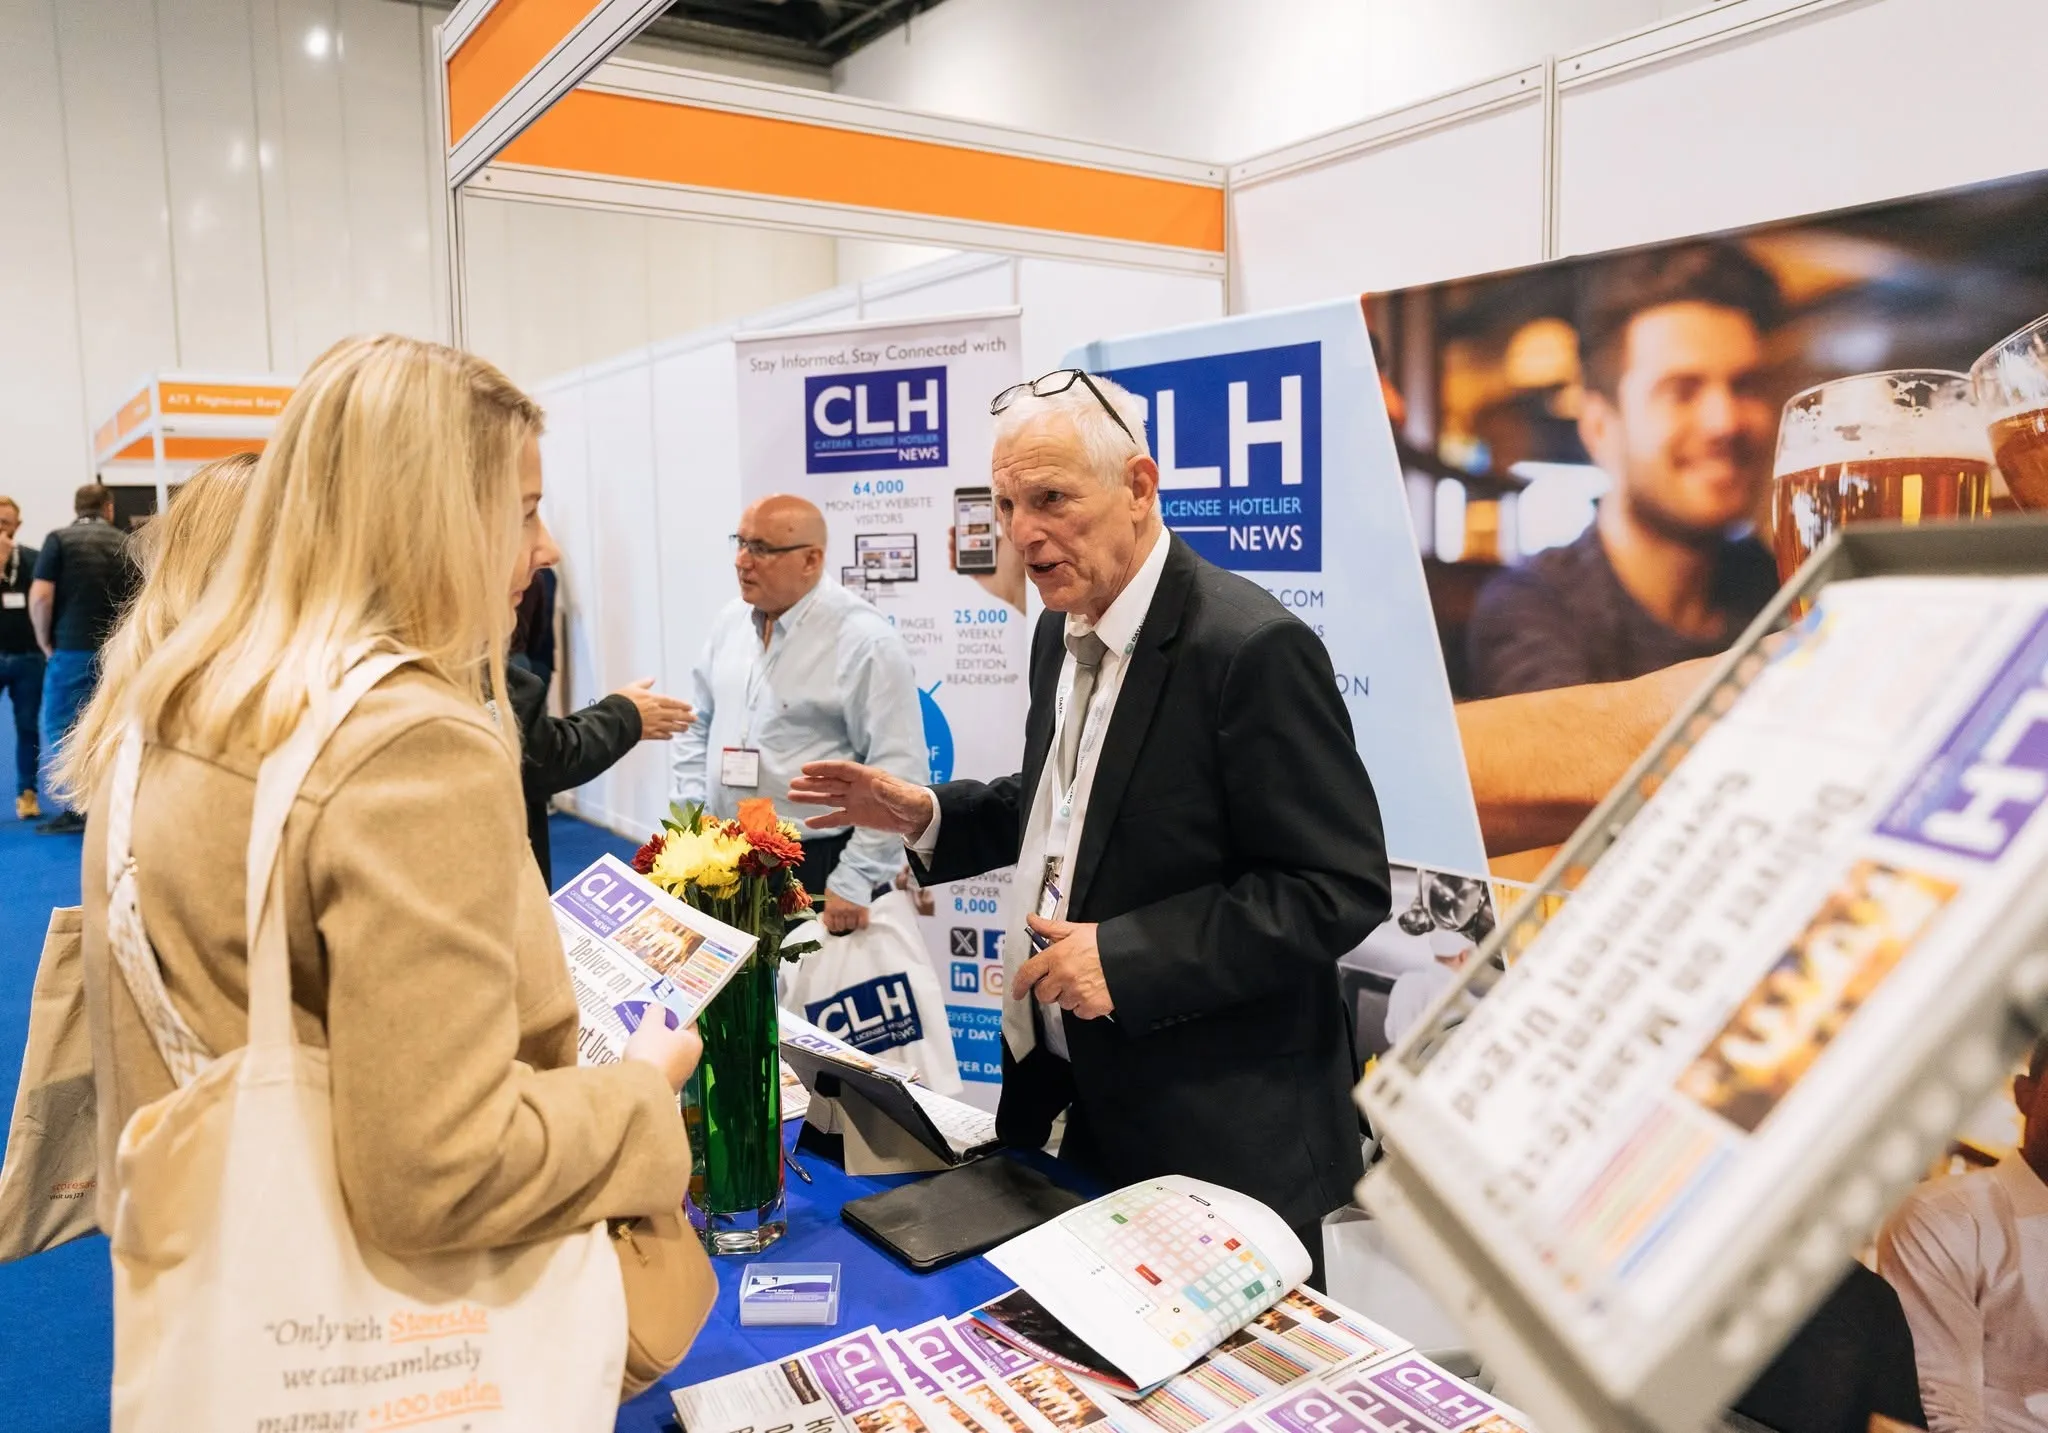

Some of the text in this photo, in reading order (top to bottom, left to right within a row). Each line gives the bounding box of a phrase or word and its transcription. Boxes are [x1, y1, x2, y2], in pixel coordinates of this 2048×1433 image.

[750, 336, 1006, 374] Stay Informed, Stay Connected with
[813, 379, 939, 436] CLH
[1135, 375, 1302, 490] LH
[899, 446, 939, 461] NEWS
[853, 480, 904, 497] 64,000
[825, 496, 934, 512] MONTHLY WEBSITE
[1160, 497, 1302, 517] LICENSEE HOTELIER
[855, 513, 904, 526] VISITORS
[1230, 524, 1303, 551] NEWS
[954, 609, 1008, 625] 25,000
[902, 632, 943, 644] ONTH
[957, 628, 1004, 640] WEEKLY
[957, 643, 1004, 656] DIGITAL
[956, 658, 1007, 671] EDITION
[946, 673, 1019, 686] READERSHIP
[580, 872, 645, 923] CLH
[950, 884, 1001, 898] OF OVER
[954, 897, 997, 914] 8,000
[591, 918, 612, 934] NEWS
[606, 971, 633, 994] on
[816, 981, 912, 1039] CLH
[968, 1029, 995, 1041] DAY
[984, 1062, 1003, 1075] DA
[282, 1368, 315, 1390] we
[360, 1340, 484, 1384] seamlessly
[836, 1342, 897, 1405] CLH
[1396, 1367, 1483, 1419] CLH
[1424, 1407, 1453, 1426] NEWS
